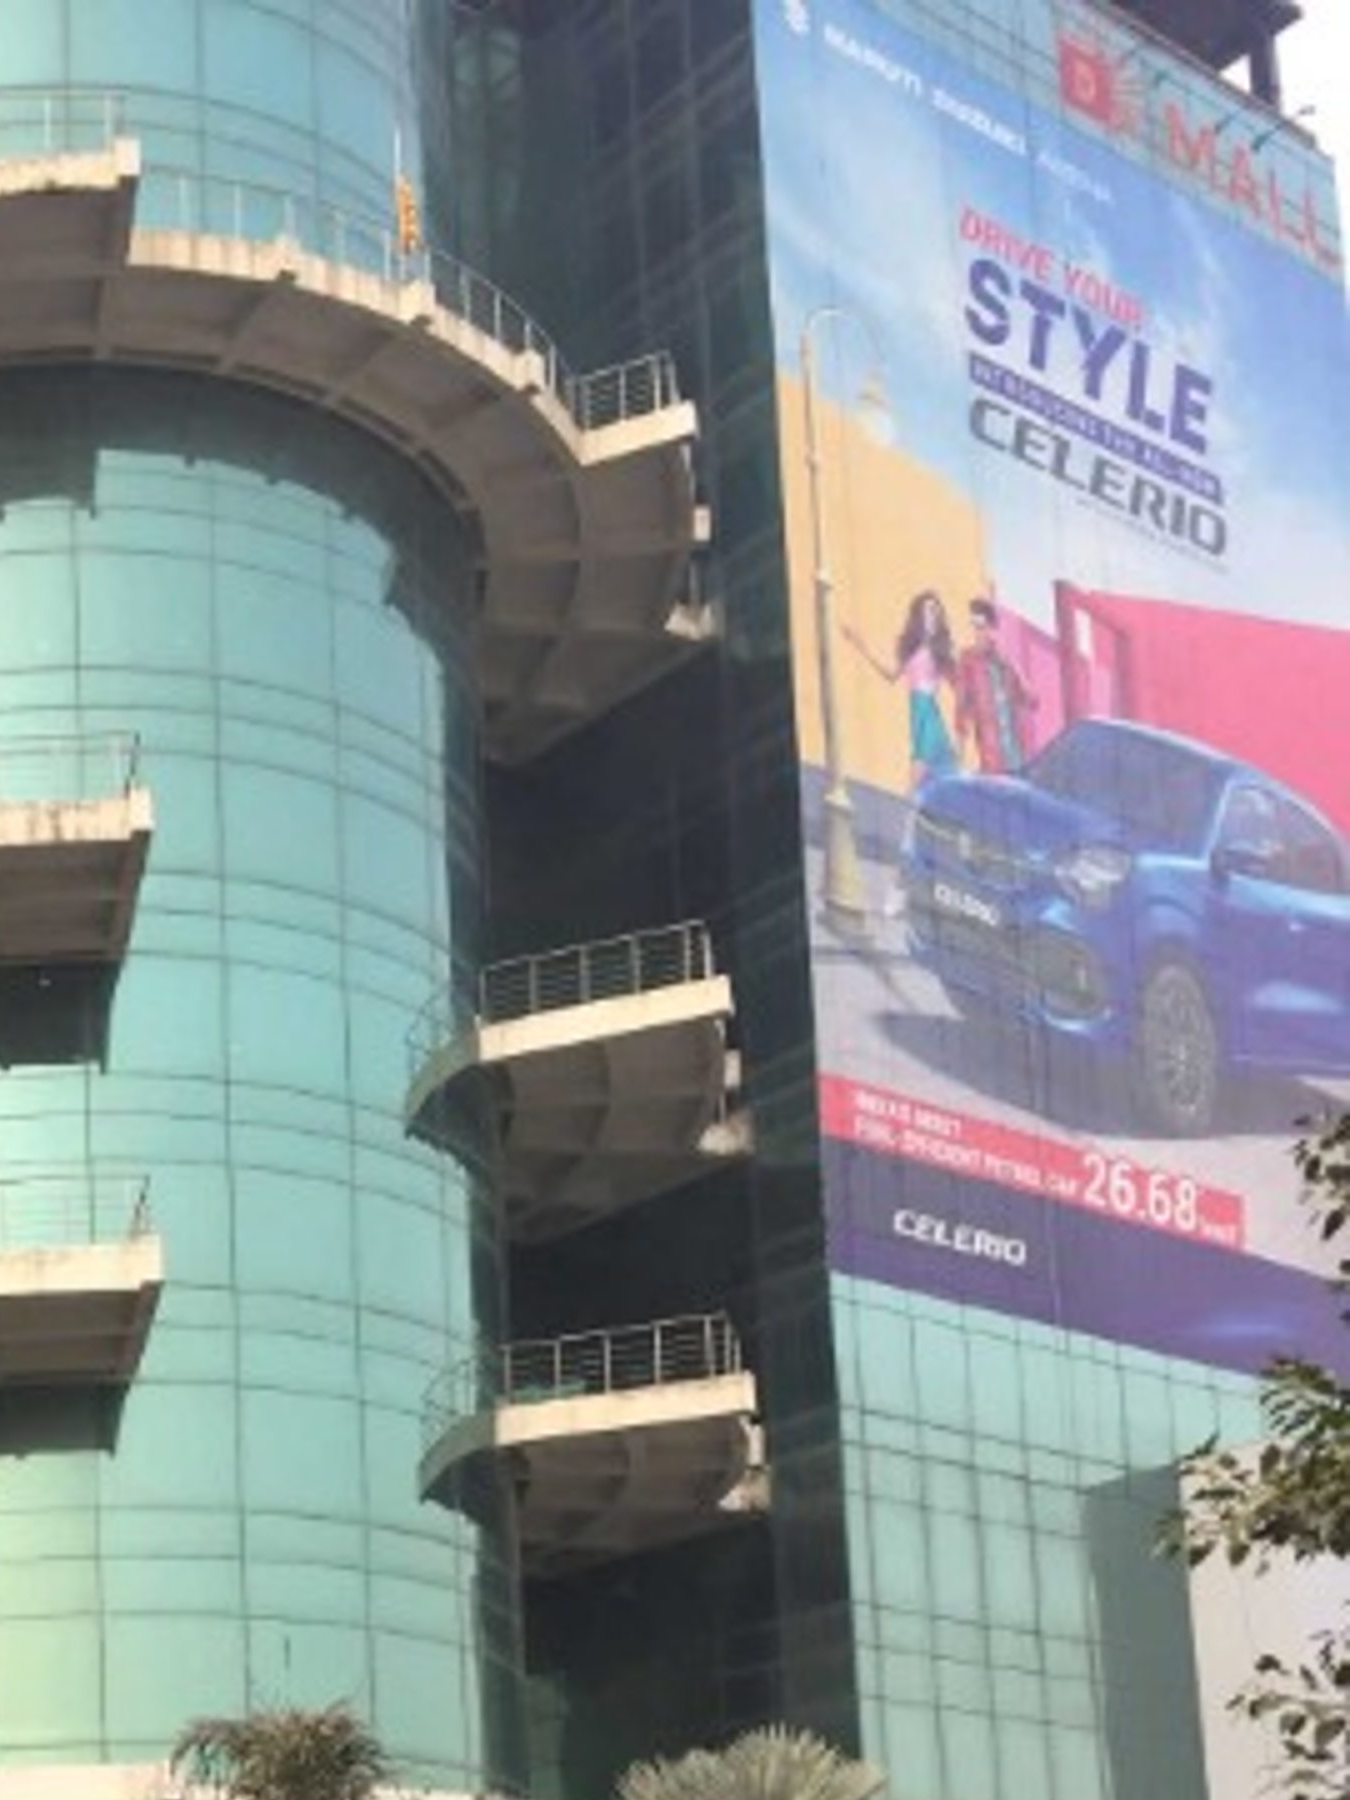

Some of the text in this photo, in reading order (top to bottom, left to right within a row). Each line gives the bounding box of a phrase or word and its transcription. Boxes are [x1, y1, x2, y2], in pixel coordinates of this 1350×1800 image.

[958, 203, 1055, 285] DRIVE
[1160, 96, 1345, 270] MALL
[963, 257, 1213, 457] STYLE
[968, 394, 1227, 557] CELERIO
[892, 1207, 1028, 1267] CELERIO
[1082, 1152, 1199, 1233] 26.68
